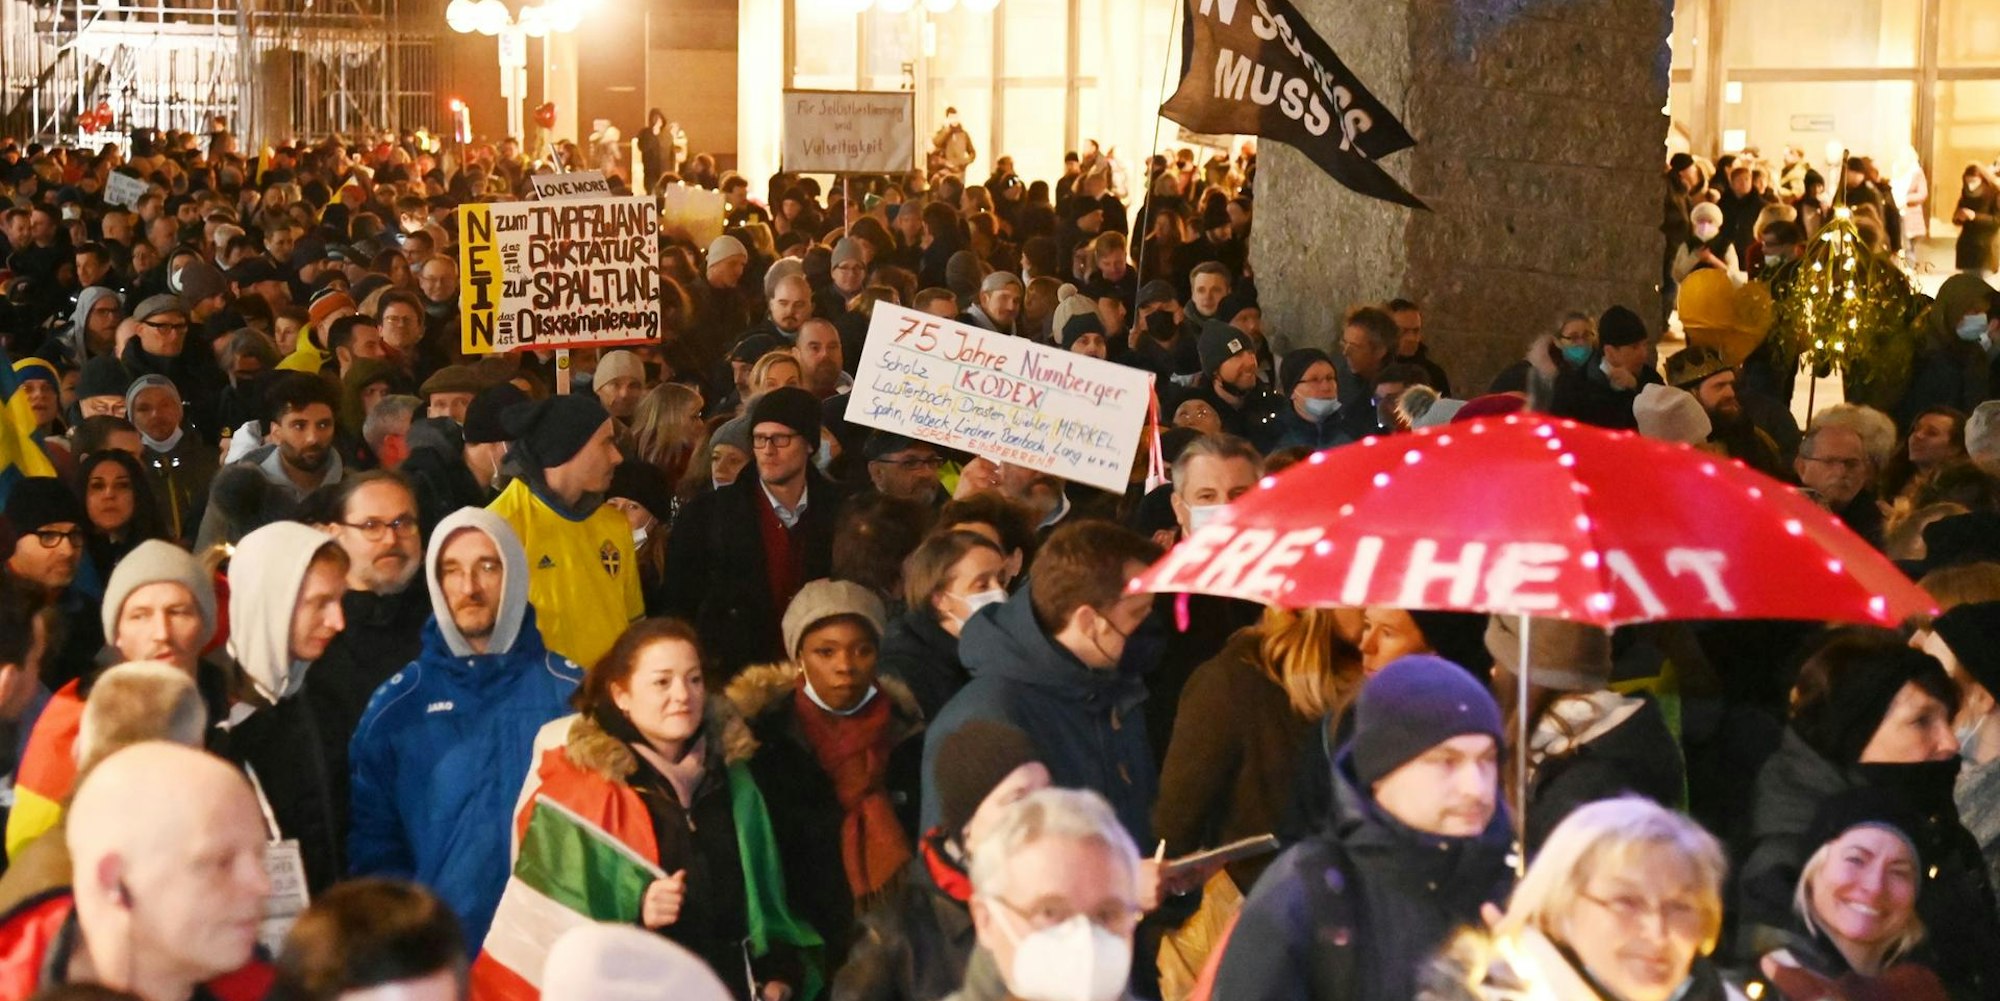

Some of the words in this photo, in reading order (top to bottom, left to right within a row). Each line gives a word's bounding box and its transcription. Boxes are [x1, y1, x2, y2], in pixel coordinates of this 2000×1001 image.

[1214, 48, 1331, 136] MUSS
[537, 182, 572, 198] LOVE
[572, 180, 607, 194] MORE
[495, 214, 528, 232] zum
[528, 203, 656, 240] IMPFZWANG
[501, 243, 521, 252] das
[467, 210, 494, 347] NEIN
[532, 266, 660, 309] SPALTUNG
[497, 311, 515, 321] das
[893, 316, 941, 352] 75
[943, 329, 1008, 371] Jahre
[1020, 349, 1128, 406] Nürnberger
[960, 369, 1044, 408] KODEX
